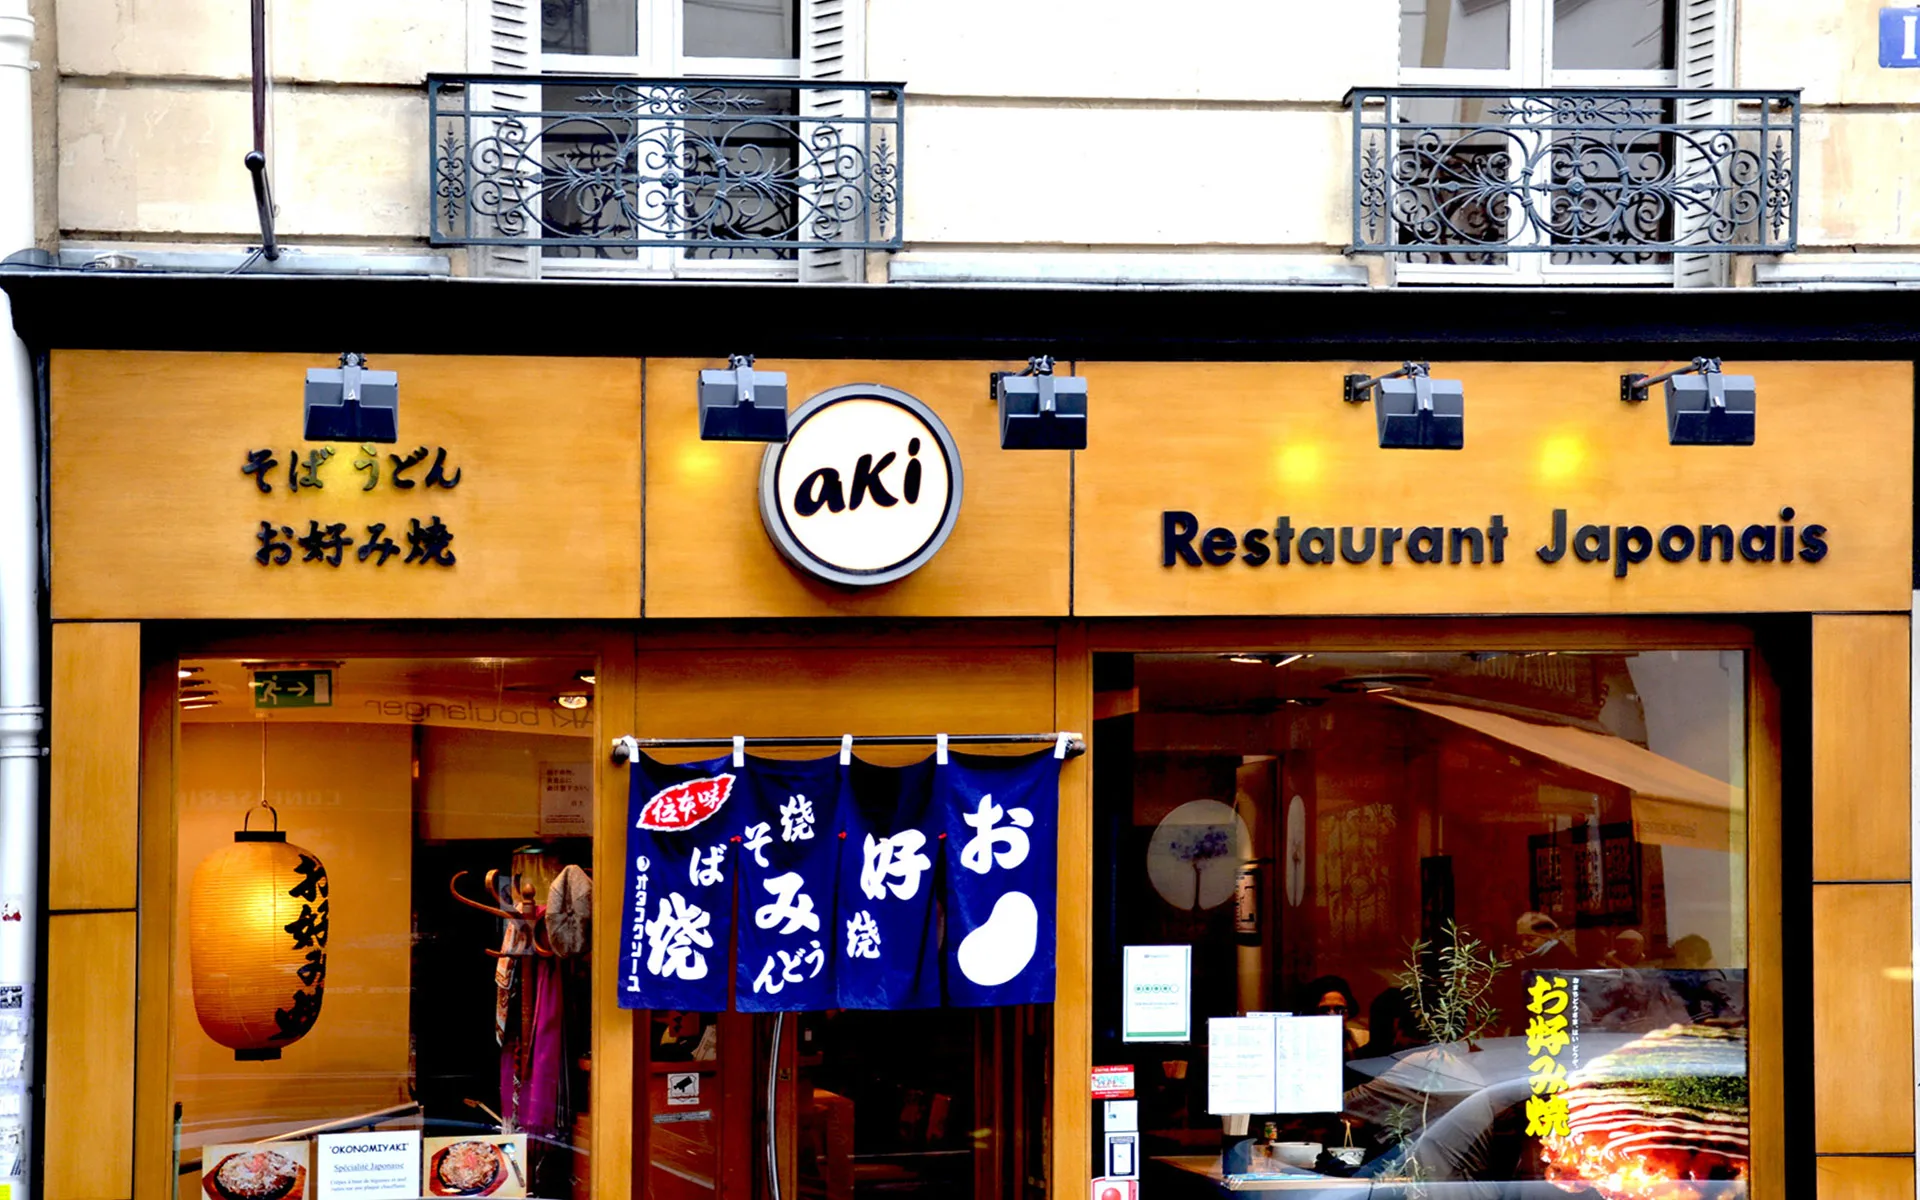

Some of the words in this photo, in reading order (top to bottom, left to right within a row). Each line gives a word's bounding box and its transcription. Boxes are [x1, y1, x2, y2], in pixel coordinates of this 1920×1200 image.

[242, 445, 335, 492] そば
[354, 442, 461, 491] うどん
[256, 515, 457, 567] お好み焼
[1162, 509, 1508, 568] Restaurant
[1536, 506, 1829, 578] Japonais
[1525, 975, 1571, 1137] お好み焼
